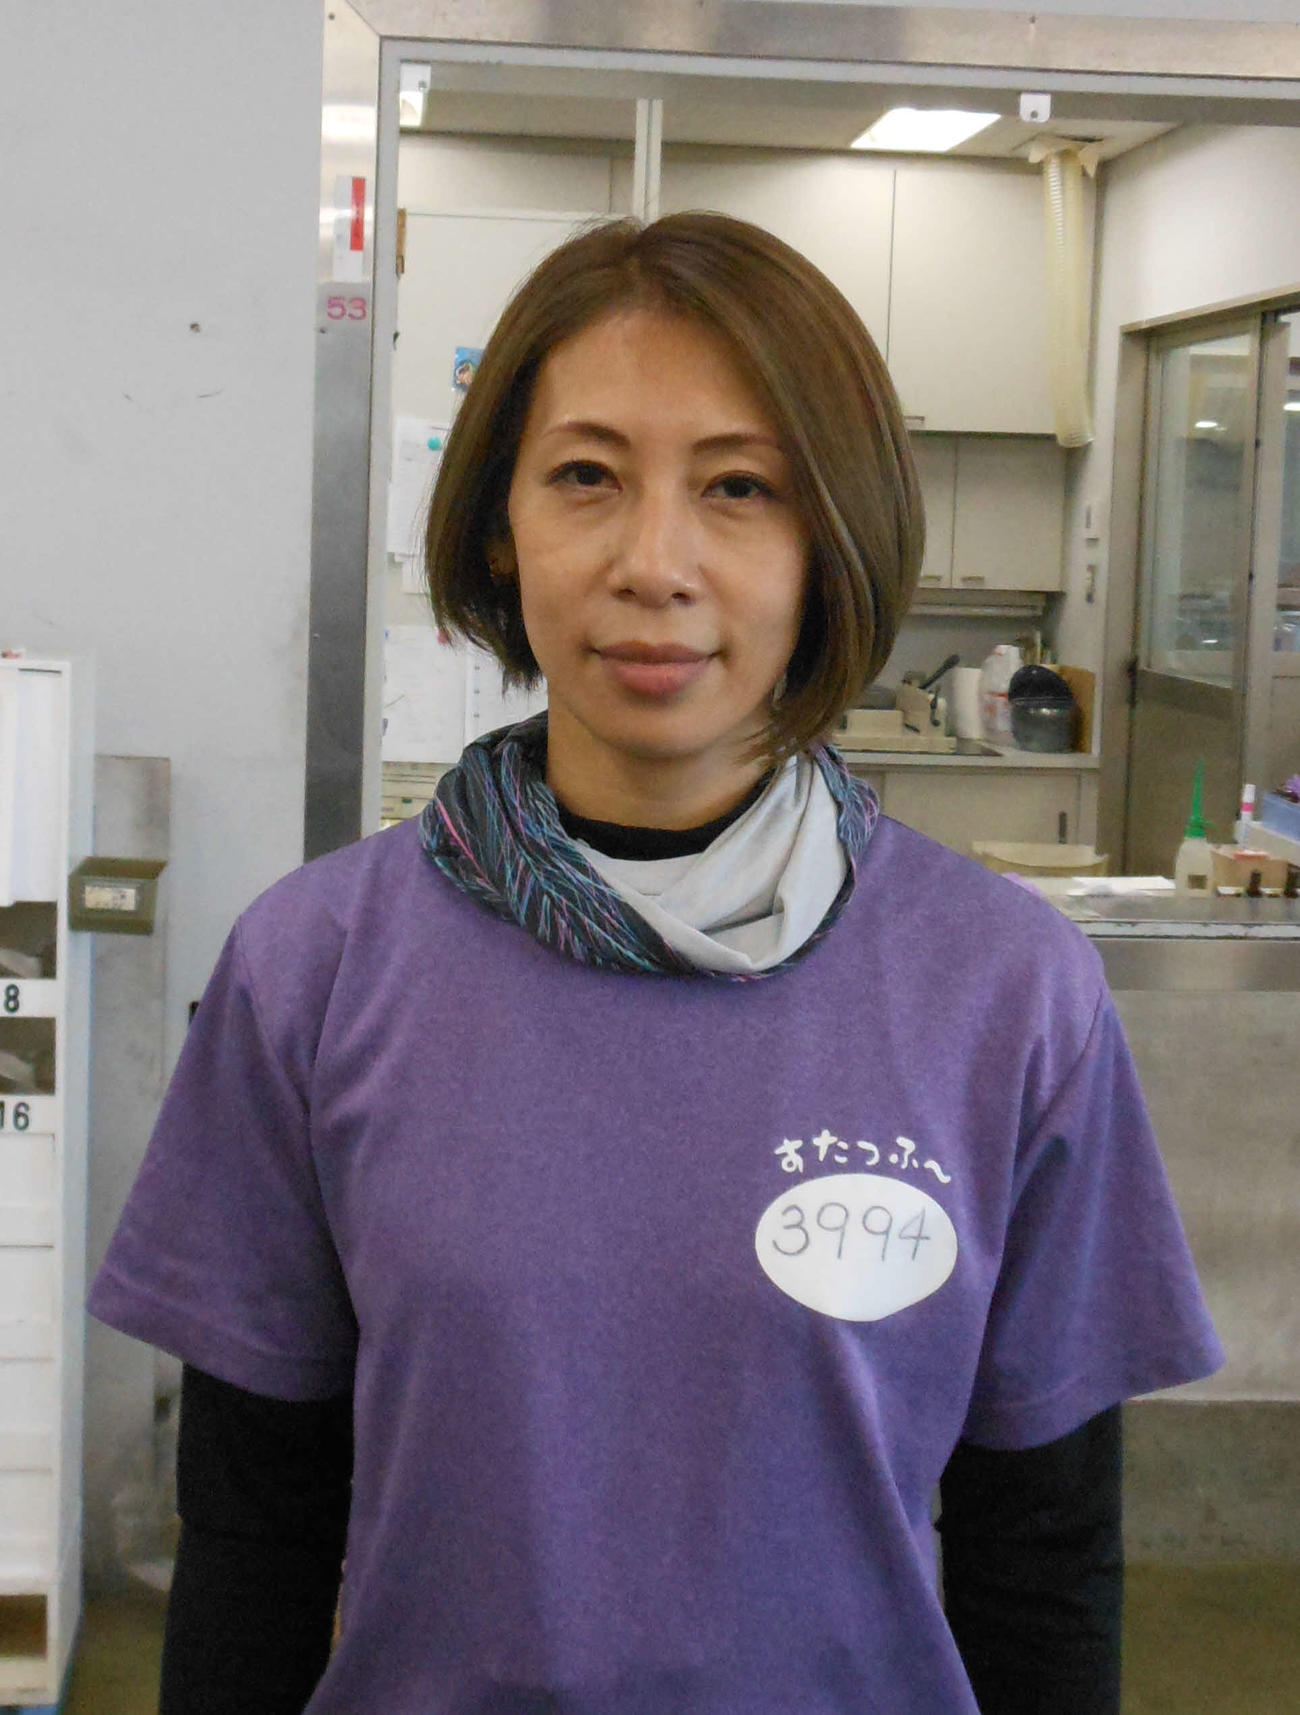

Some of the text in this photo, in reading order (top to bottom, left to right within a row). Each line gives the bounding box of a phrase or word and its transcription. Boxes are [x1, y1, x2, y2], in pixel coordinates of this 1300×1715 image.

[326, 296, 367, 320] 53
[4, 984, 20, 1013] 8
[772, 1202, 931, 1262] 3994
